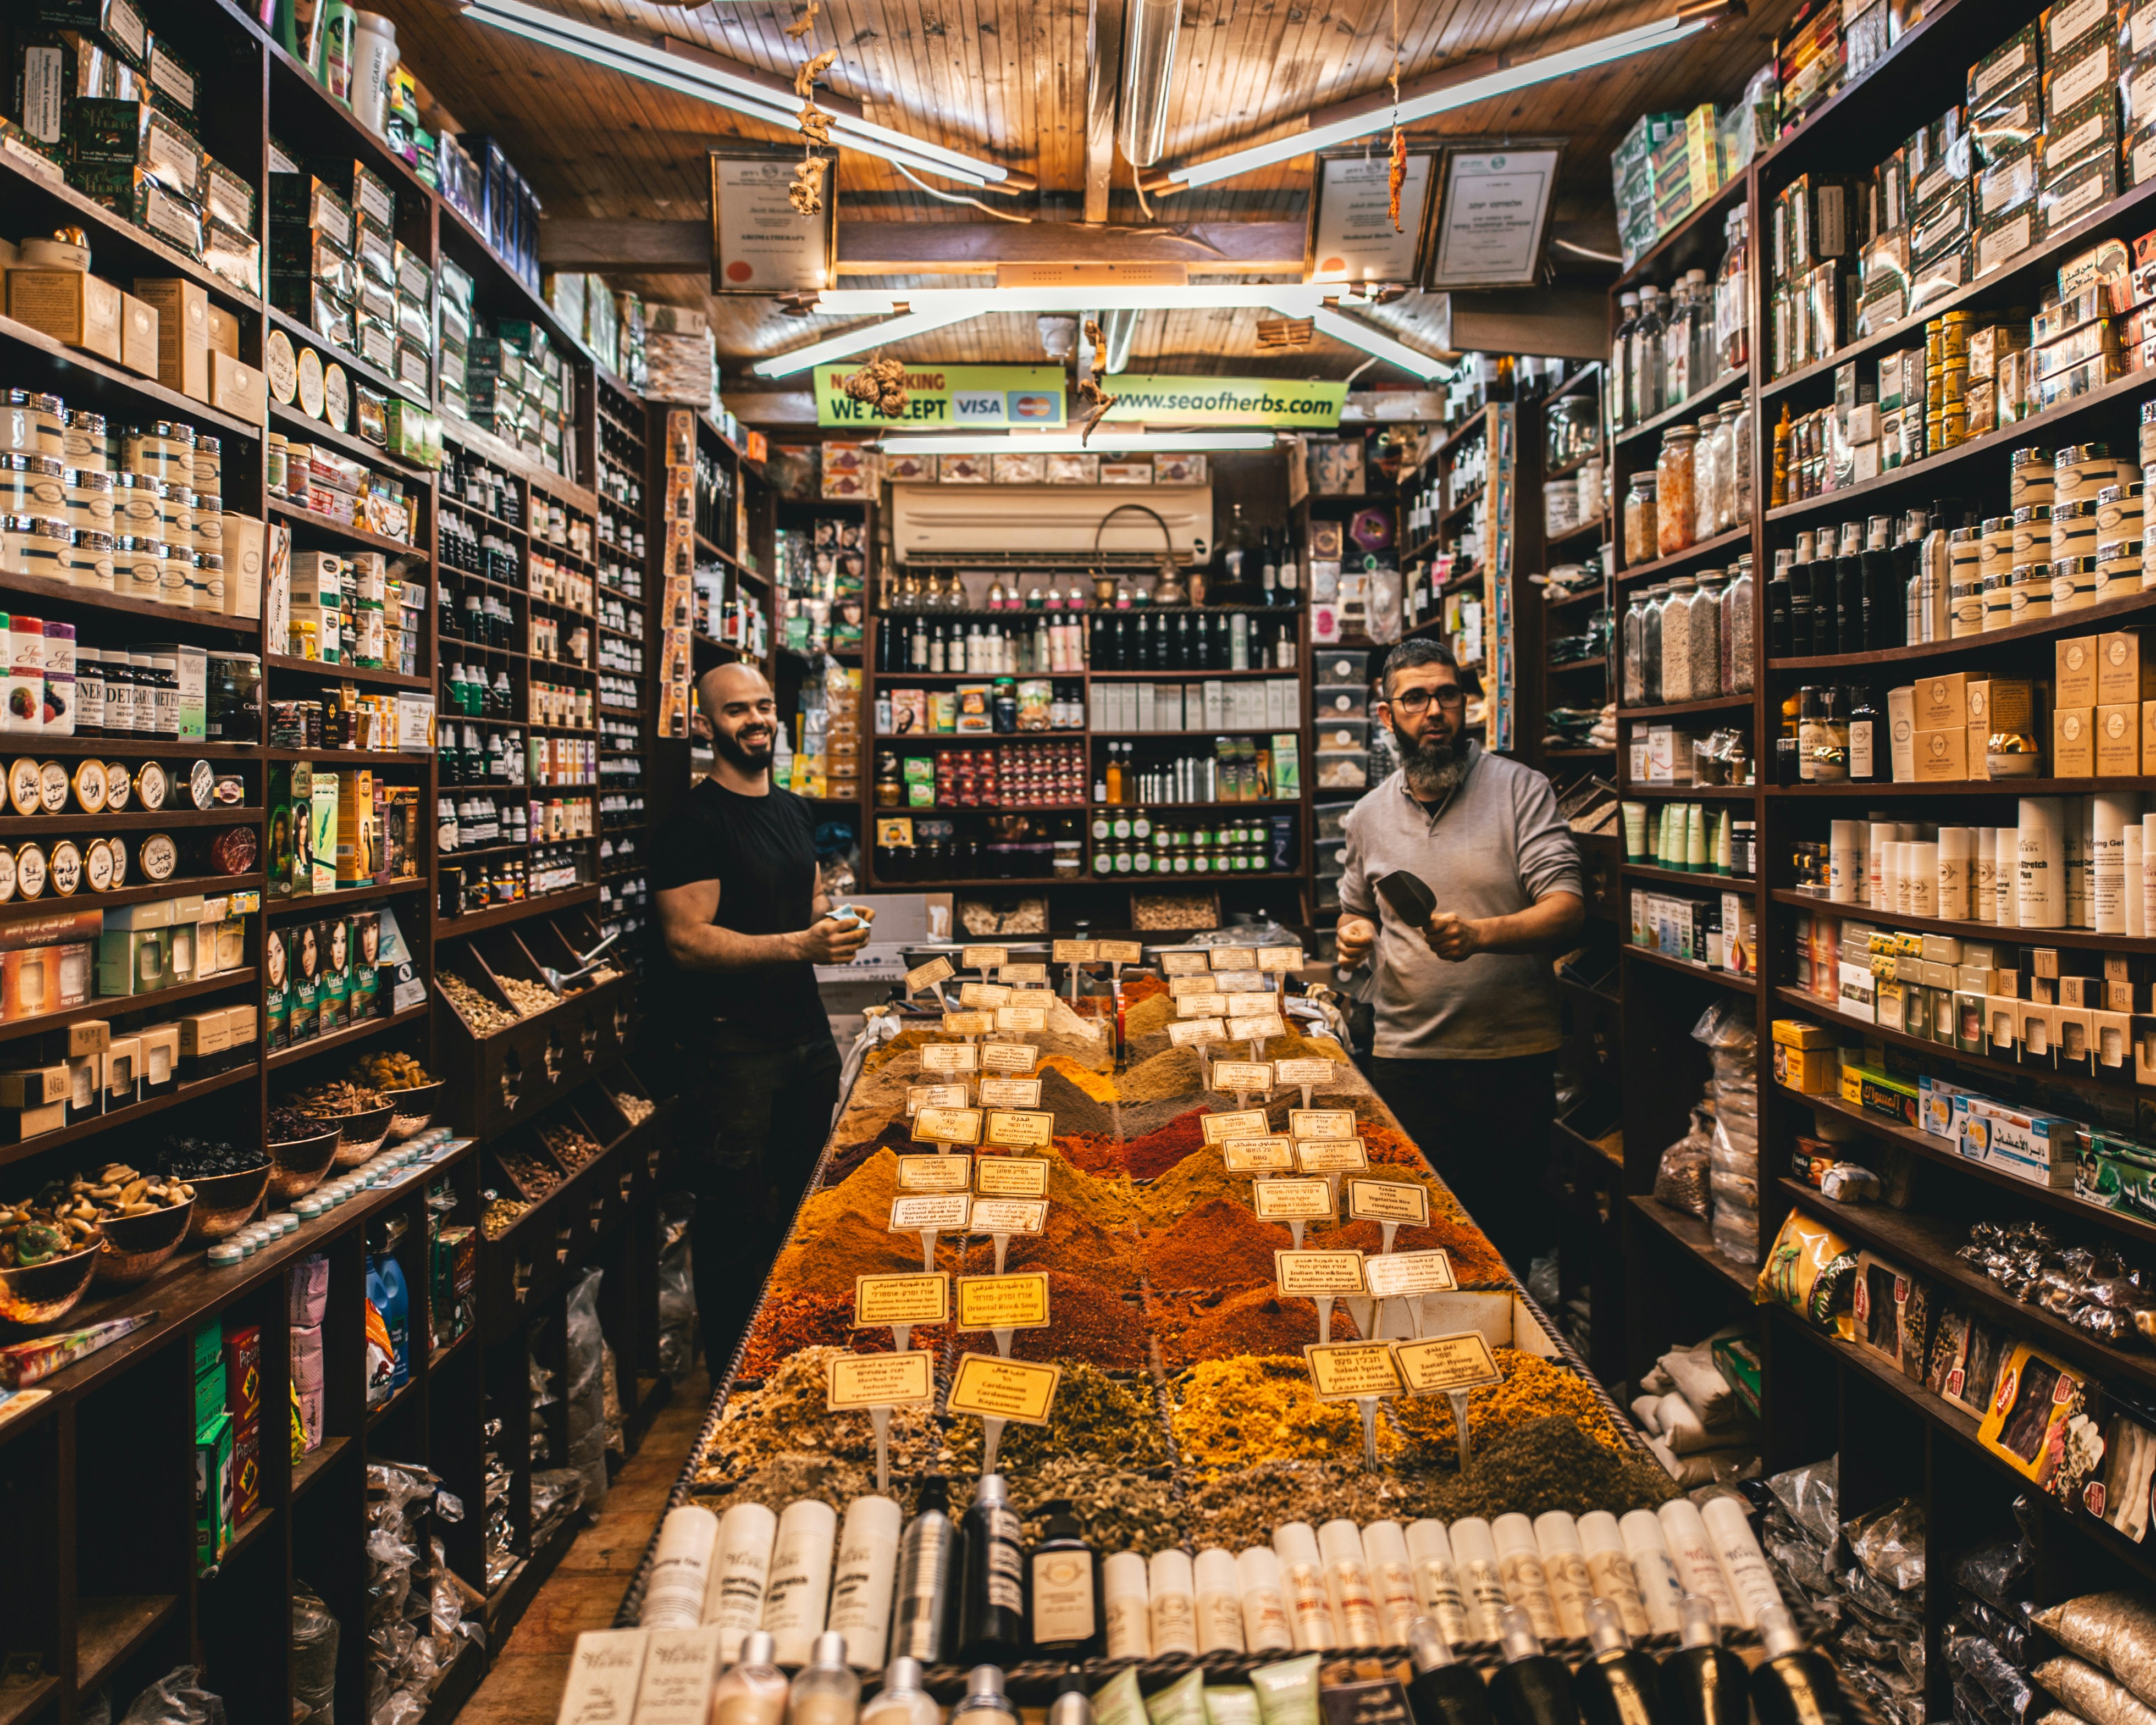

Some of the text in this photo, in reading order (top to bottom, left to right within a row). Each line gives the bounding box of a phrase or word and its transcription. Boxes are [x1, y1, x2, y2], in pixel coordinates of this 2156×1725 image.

[373, 48, 382, 83] GARLIC
[831, 399, 864, 419] WE
[958, 399, 1001, 414] VISA
[1110, 391, 1333, 414] www.seaofherbs.com
[16, 645, 43, 662] Juice
[46, 651, 74, 667] Juice
[327, 976, 344, 988] Vatika
[359, 969, 374, 981] Vatika
[298, 986, 315, 998] Vatika
[968, 1304, 997, 1312] Oriental
